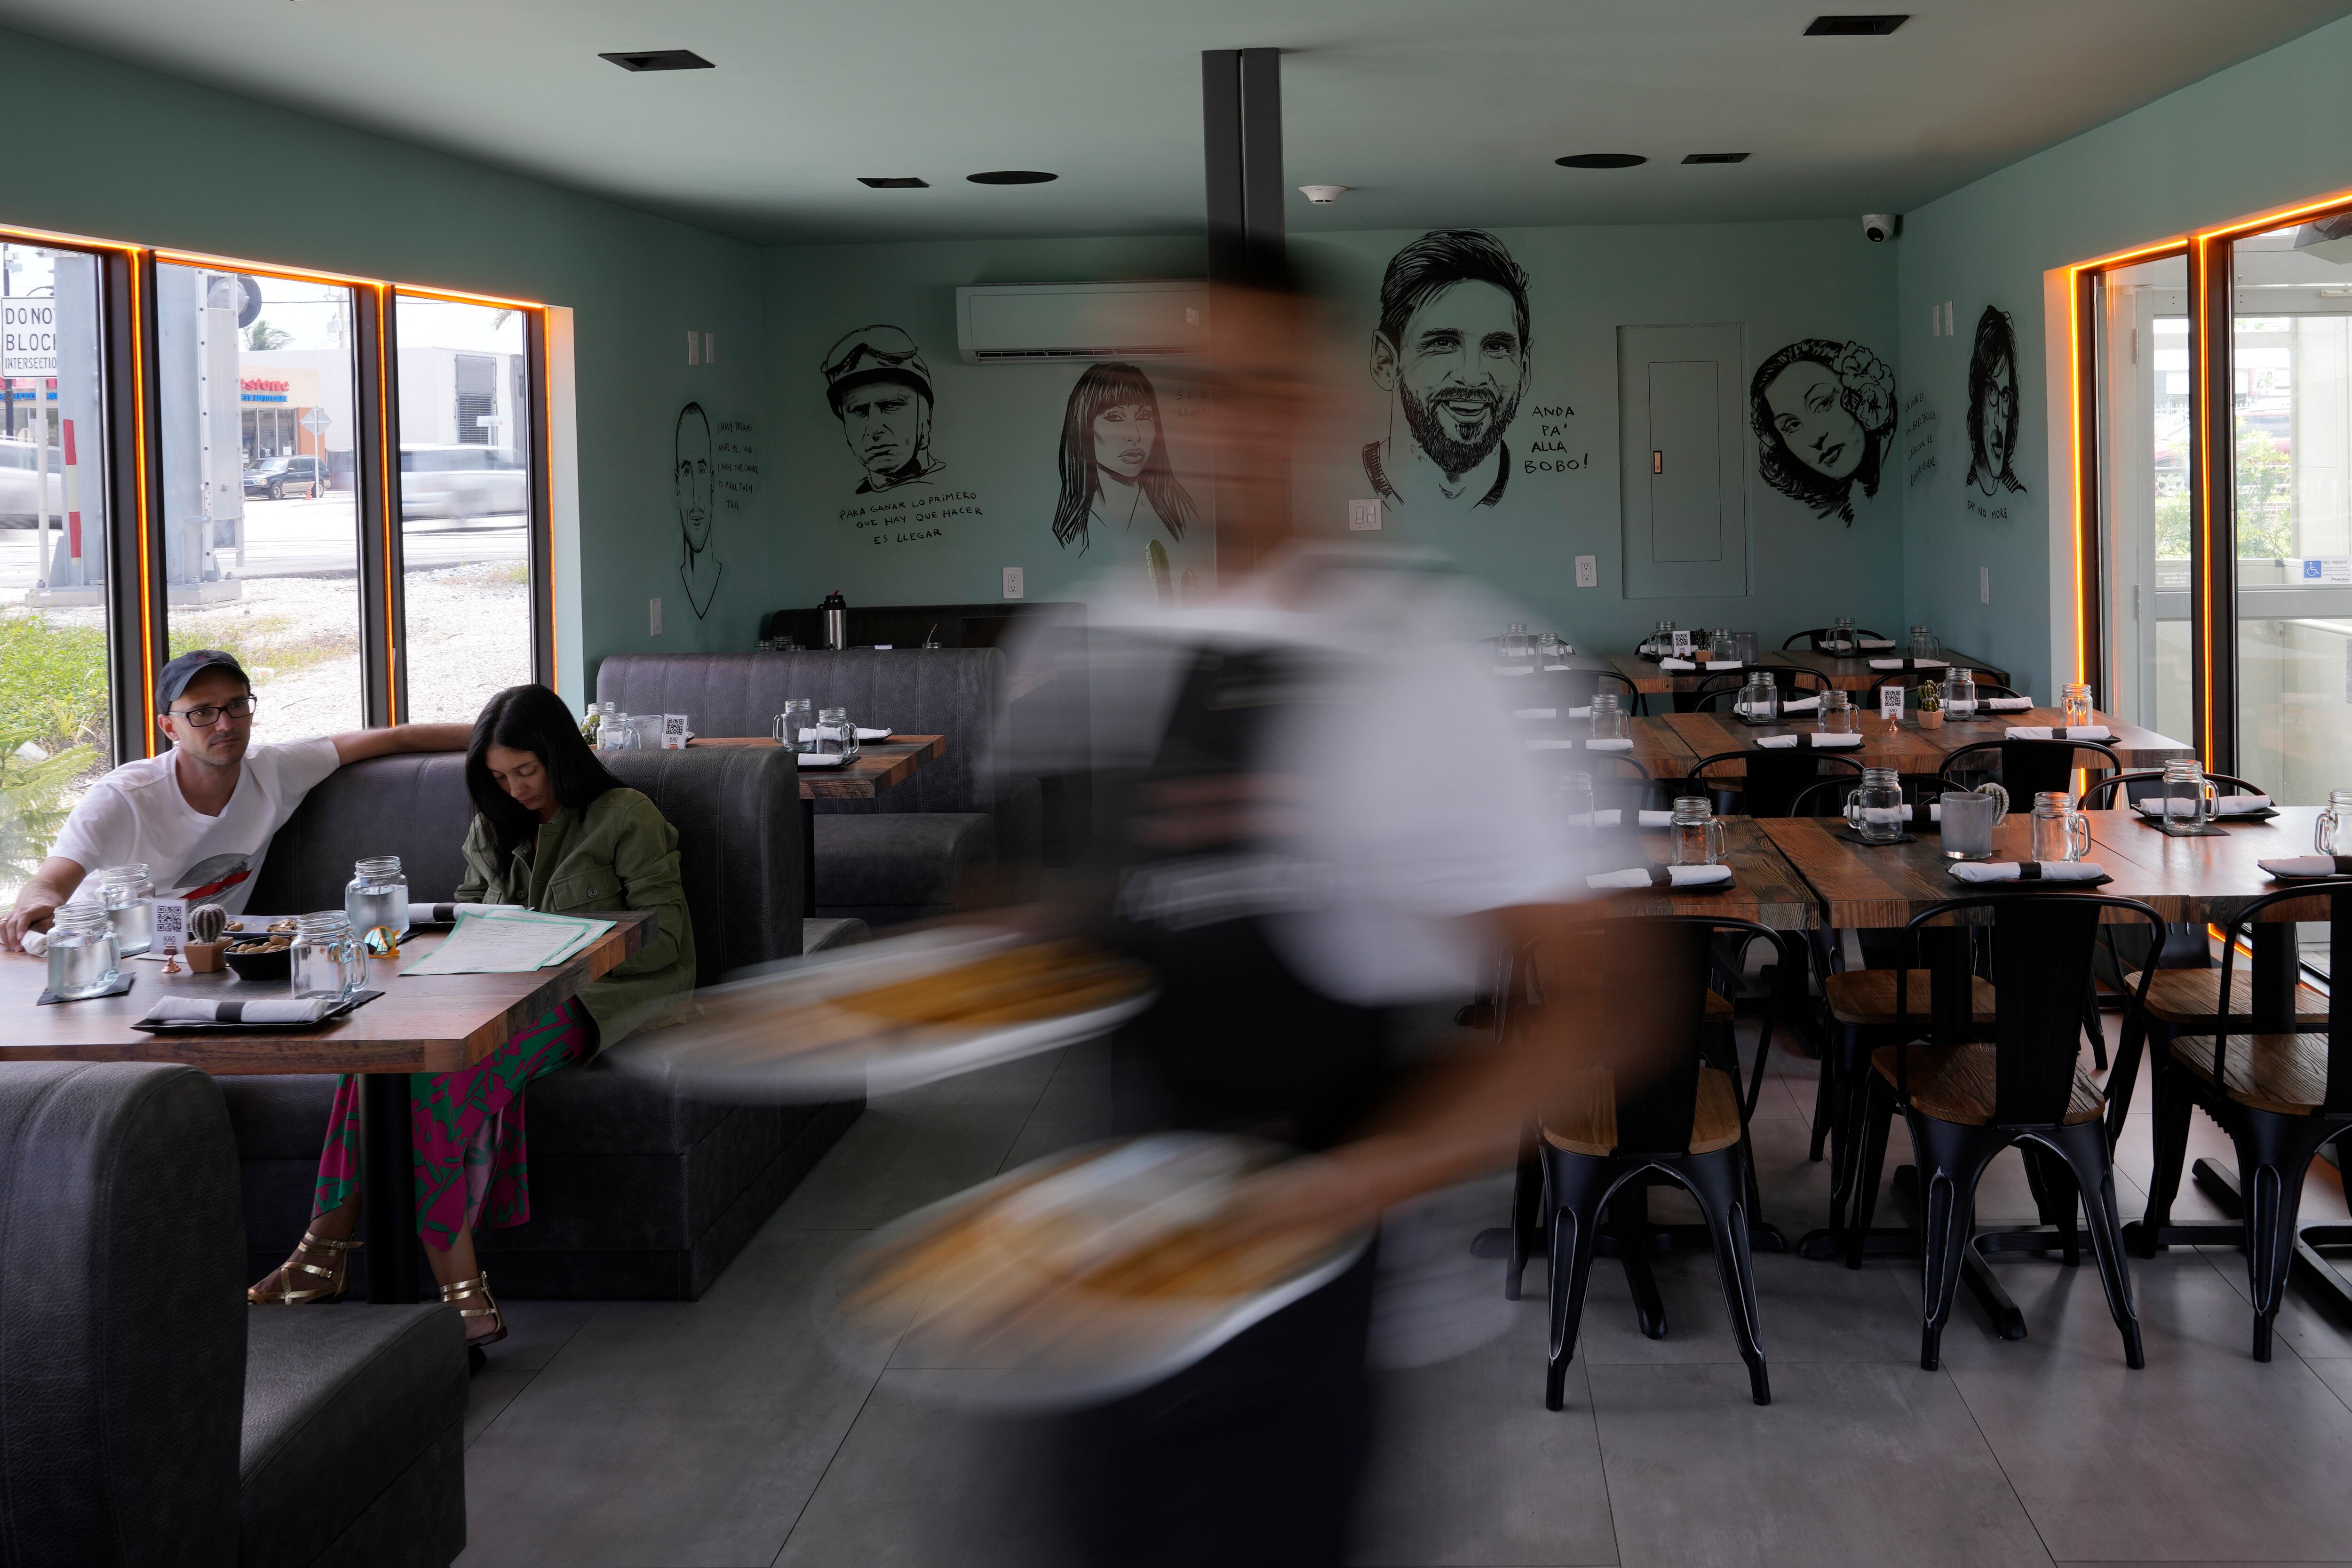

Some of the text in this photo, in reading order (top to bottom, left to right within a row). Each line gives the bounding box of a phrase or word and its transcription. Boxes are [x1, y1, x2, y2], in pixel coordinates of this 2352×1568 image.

[6, 308, 55, 325] DO NO
[5, 357, 56, 369] INTERSECTIO
[240, 378, 290, 391] estone
[1919, 393, 1924, 402] ES
[1532, 406, 1575, 418] ANDA
[717, 422, 752, 433] I HAVE DREAMS
[1542, 423, 1567, 436] PA'
[1927, 435, 1932, 444] VE
[1531, 441, 1567, 453] ALLA
[718, 463, 720, 472] I
[722, 463, 732, 471] HAVE
[744, 464, 759, 474] CHANCE
[1524, 453, 1588, 474] BOBO!
[725, 481, 738, 491] MAKE
[739, 483, 752, 493] THEM
[727, 500, 739, 509] TRUE
[839, 508, 866, 520] PARA
[870, 502, 906, 512] GANAR
[1978, 507, 1986, 517] NO
[1991, 508, 2007, 519] MORE
[857, 507, 983, 528] QUE HAY QUE HACER
[874, 529, 942, 544] ES LLEGAR
